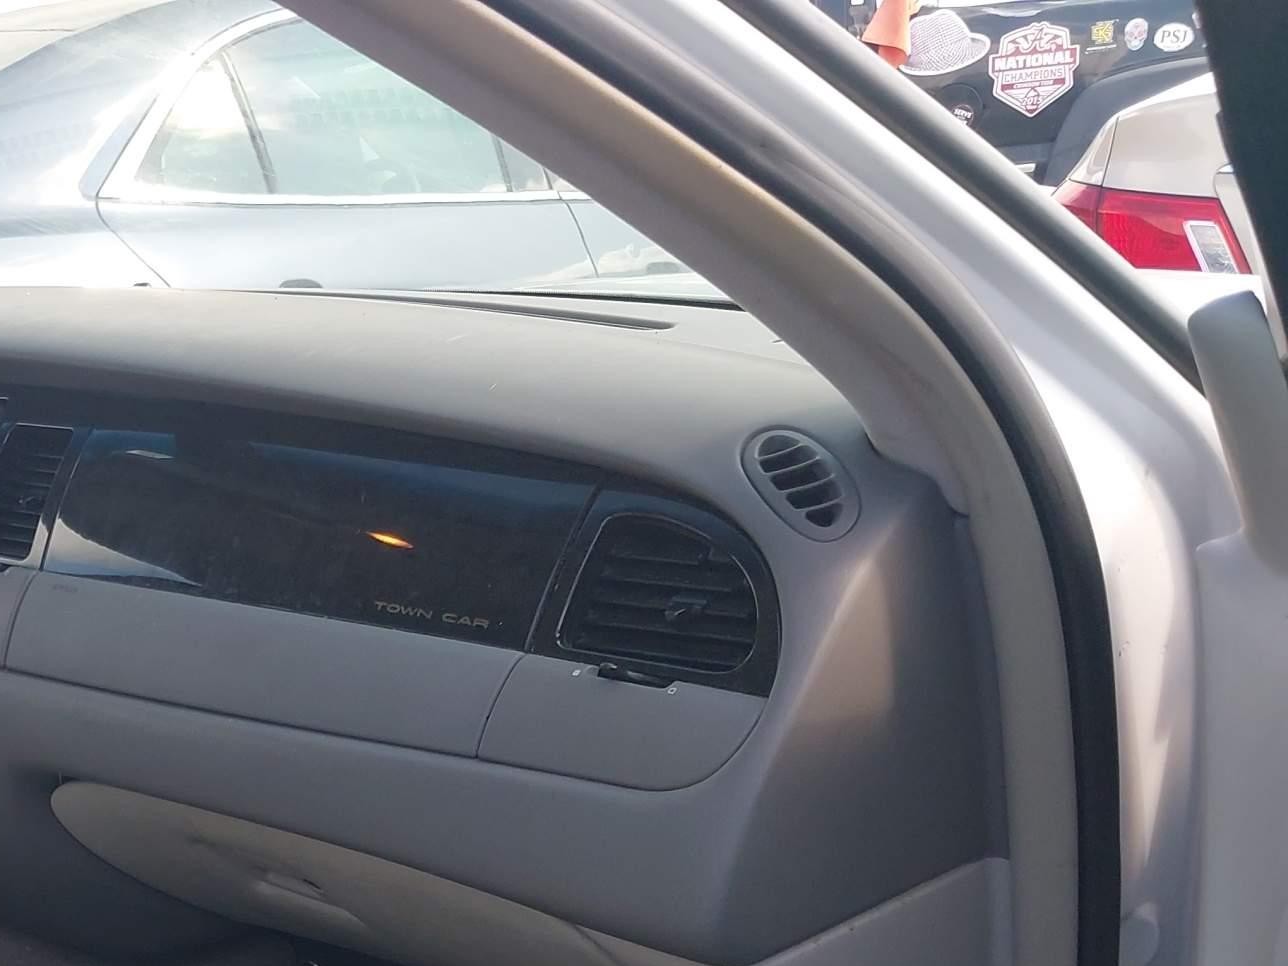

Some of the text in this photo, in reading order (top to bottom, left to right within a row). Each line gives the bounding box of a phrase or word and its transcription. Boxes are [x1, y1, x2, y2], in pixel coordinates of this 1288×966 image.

[994, 49, 1074, 71] NATIONAL
[1003, 67, 1063, 83] CHAMPIONS
[1021, 96, 1044, 106] 2015
[375, 601, 489, 629] TOWN CAR
